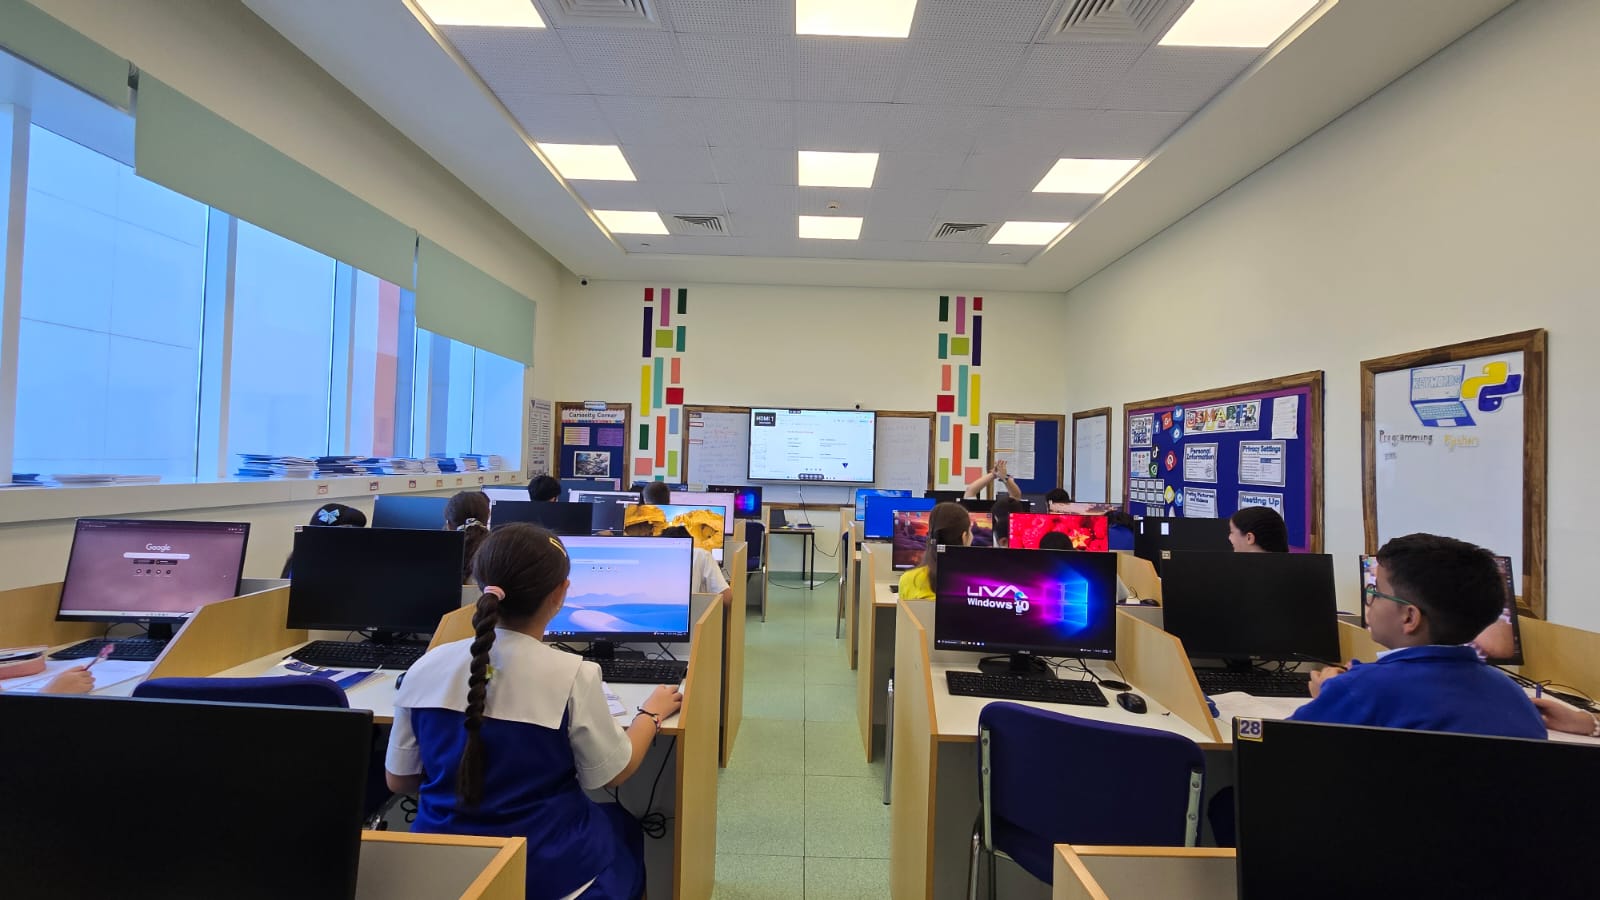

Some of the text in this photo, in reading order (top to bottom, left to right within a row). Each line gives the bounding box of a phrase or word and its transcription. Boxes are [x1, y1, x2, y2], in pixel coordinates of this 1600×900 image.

[1379, 430, 1433, 446] Programming
[1186, 452, 1214, 460] Information
[1268, 497, 1280, 507] Up
[145, 543, 172, 552] Google
[967, 585, 1029, 599] LIVA
[967, 597, 1014, 610] Windows
[1240, 720, 1261, 735] 28
